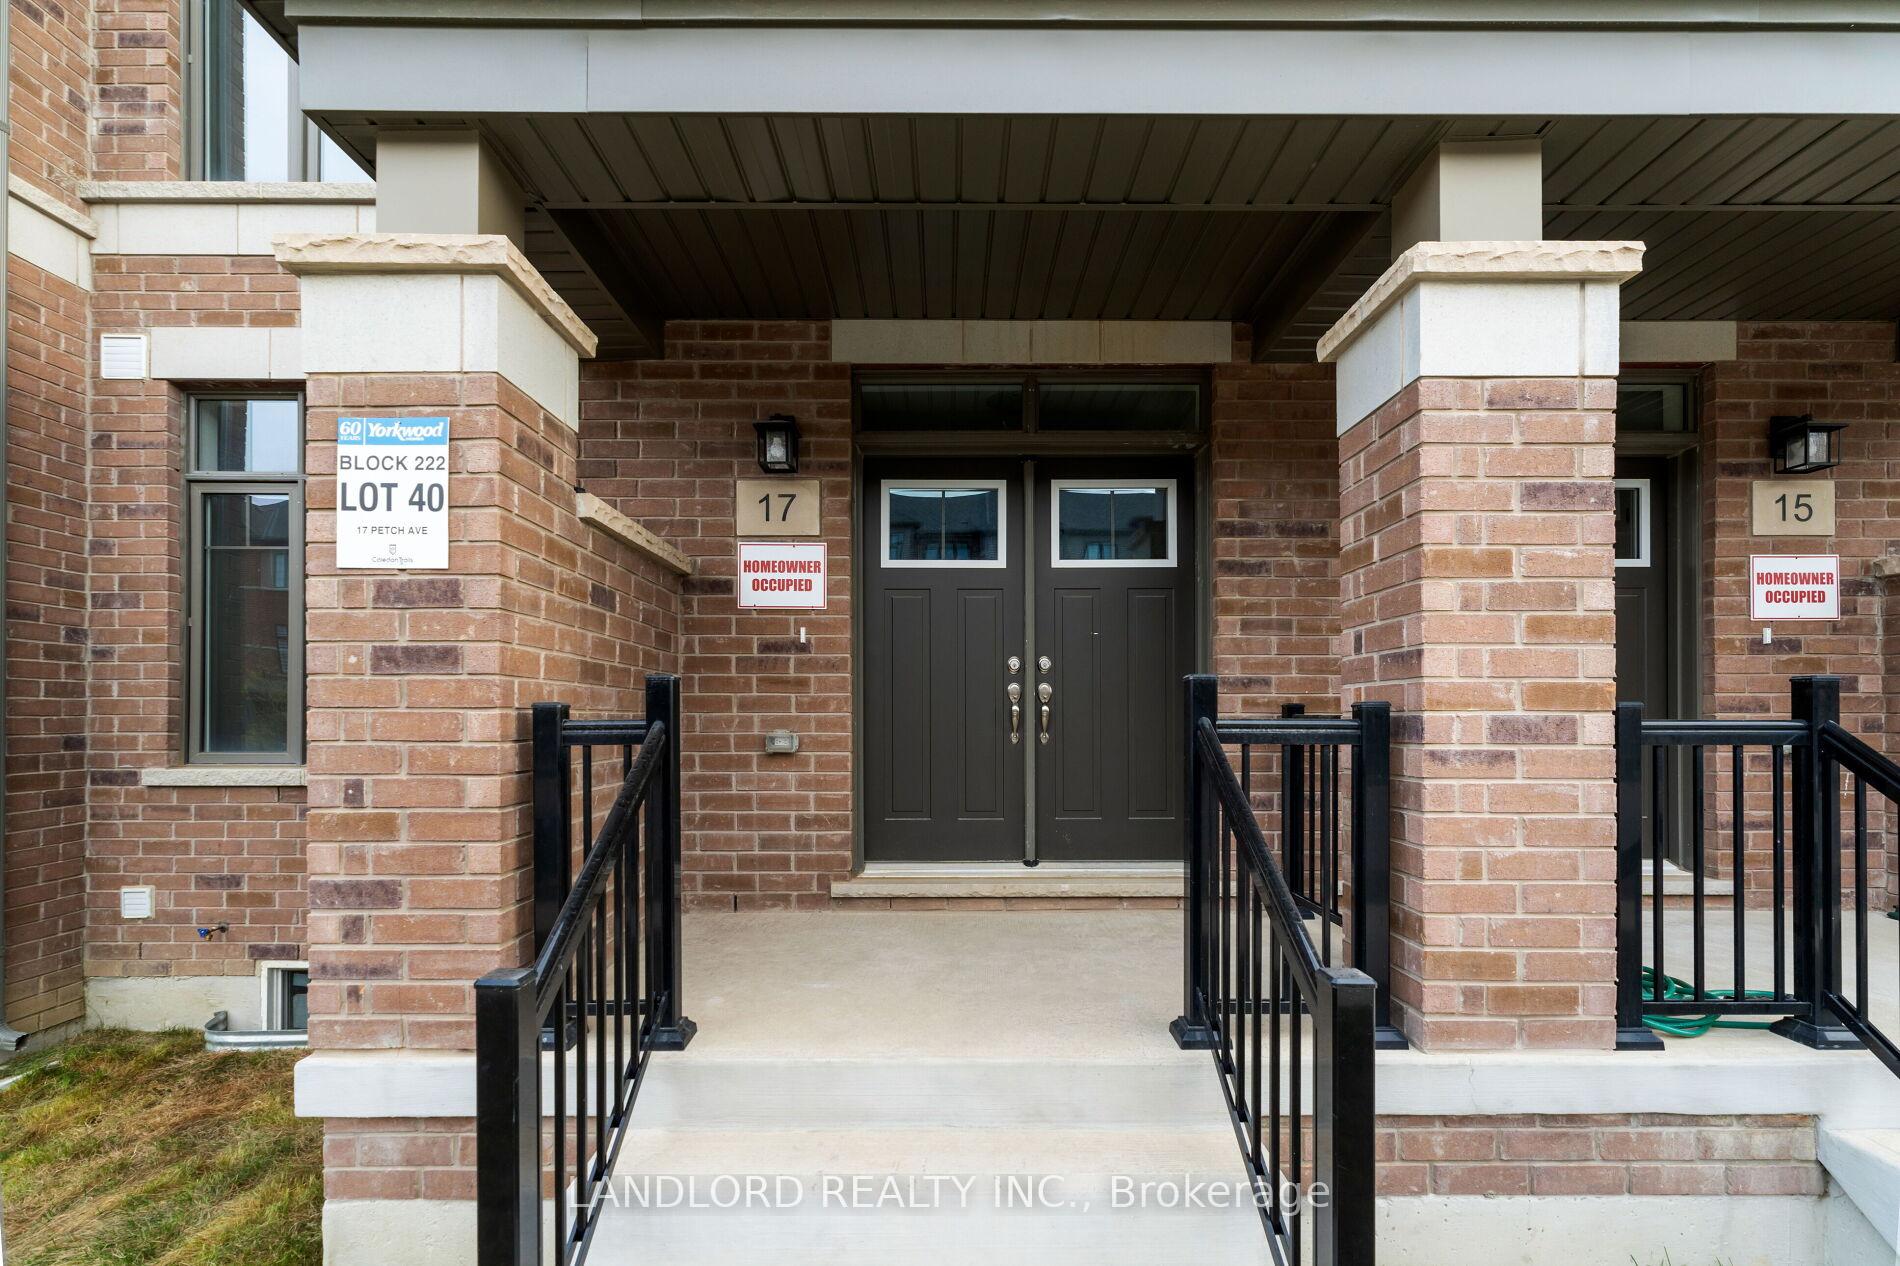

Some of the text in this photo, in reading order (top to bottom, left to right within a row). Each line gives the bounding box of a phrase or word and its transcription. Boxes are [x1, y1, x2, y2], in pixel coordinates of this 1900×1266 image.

[340, 421, 362, 436] 60
[367, 420, 444, 441] Yorkwood
[340, 455, 446, 471] BLOCK 222
[340, 482, 444, 512] LOT 40
[758, 493, 797, 522] 17
[1774, 493, 1814, 522] 15
[356, 526, 428, 535] 17 PETCH AVE
[743, 560, 822, 574] HOMEOWNER
[752, 578, 813, 592] OCCUPIED
[1756, 572, 1834, 585] HOMEOWNER
[1765, 590, 1826, 604] OCCUPIED
